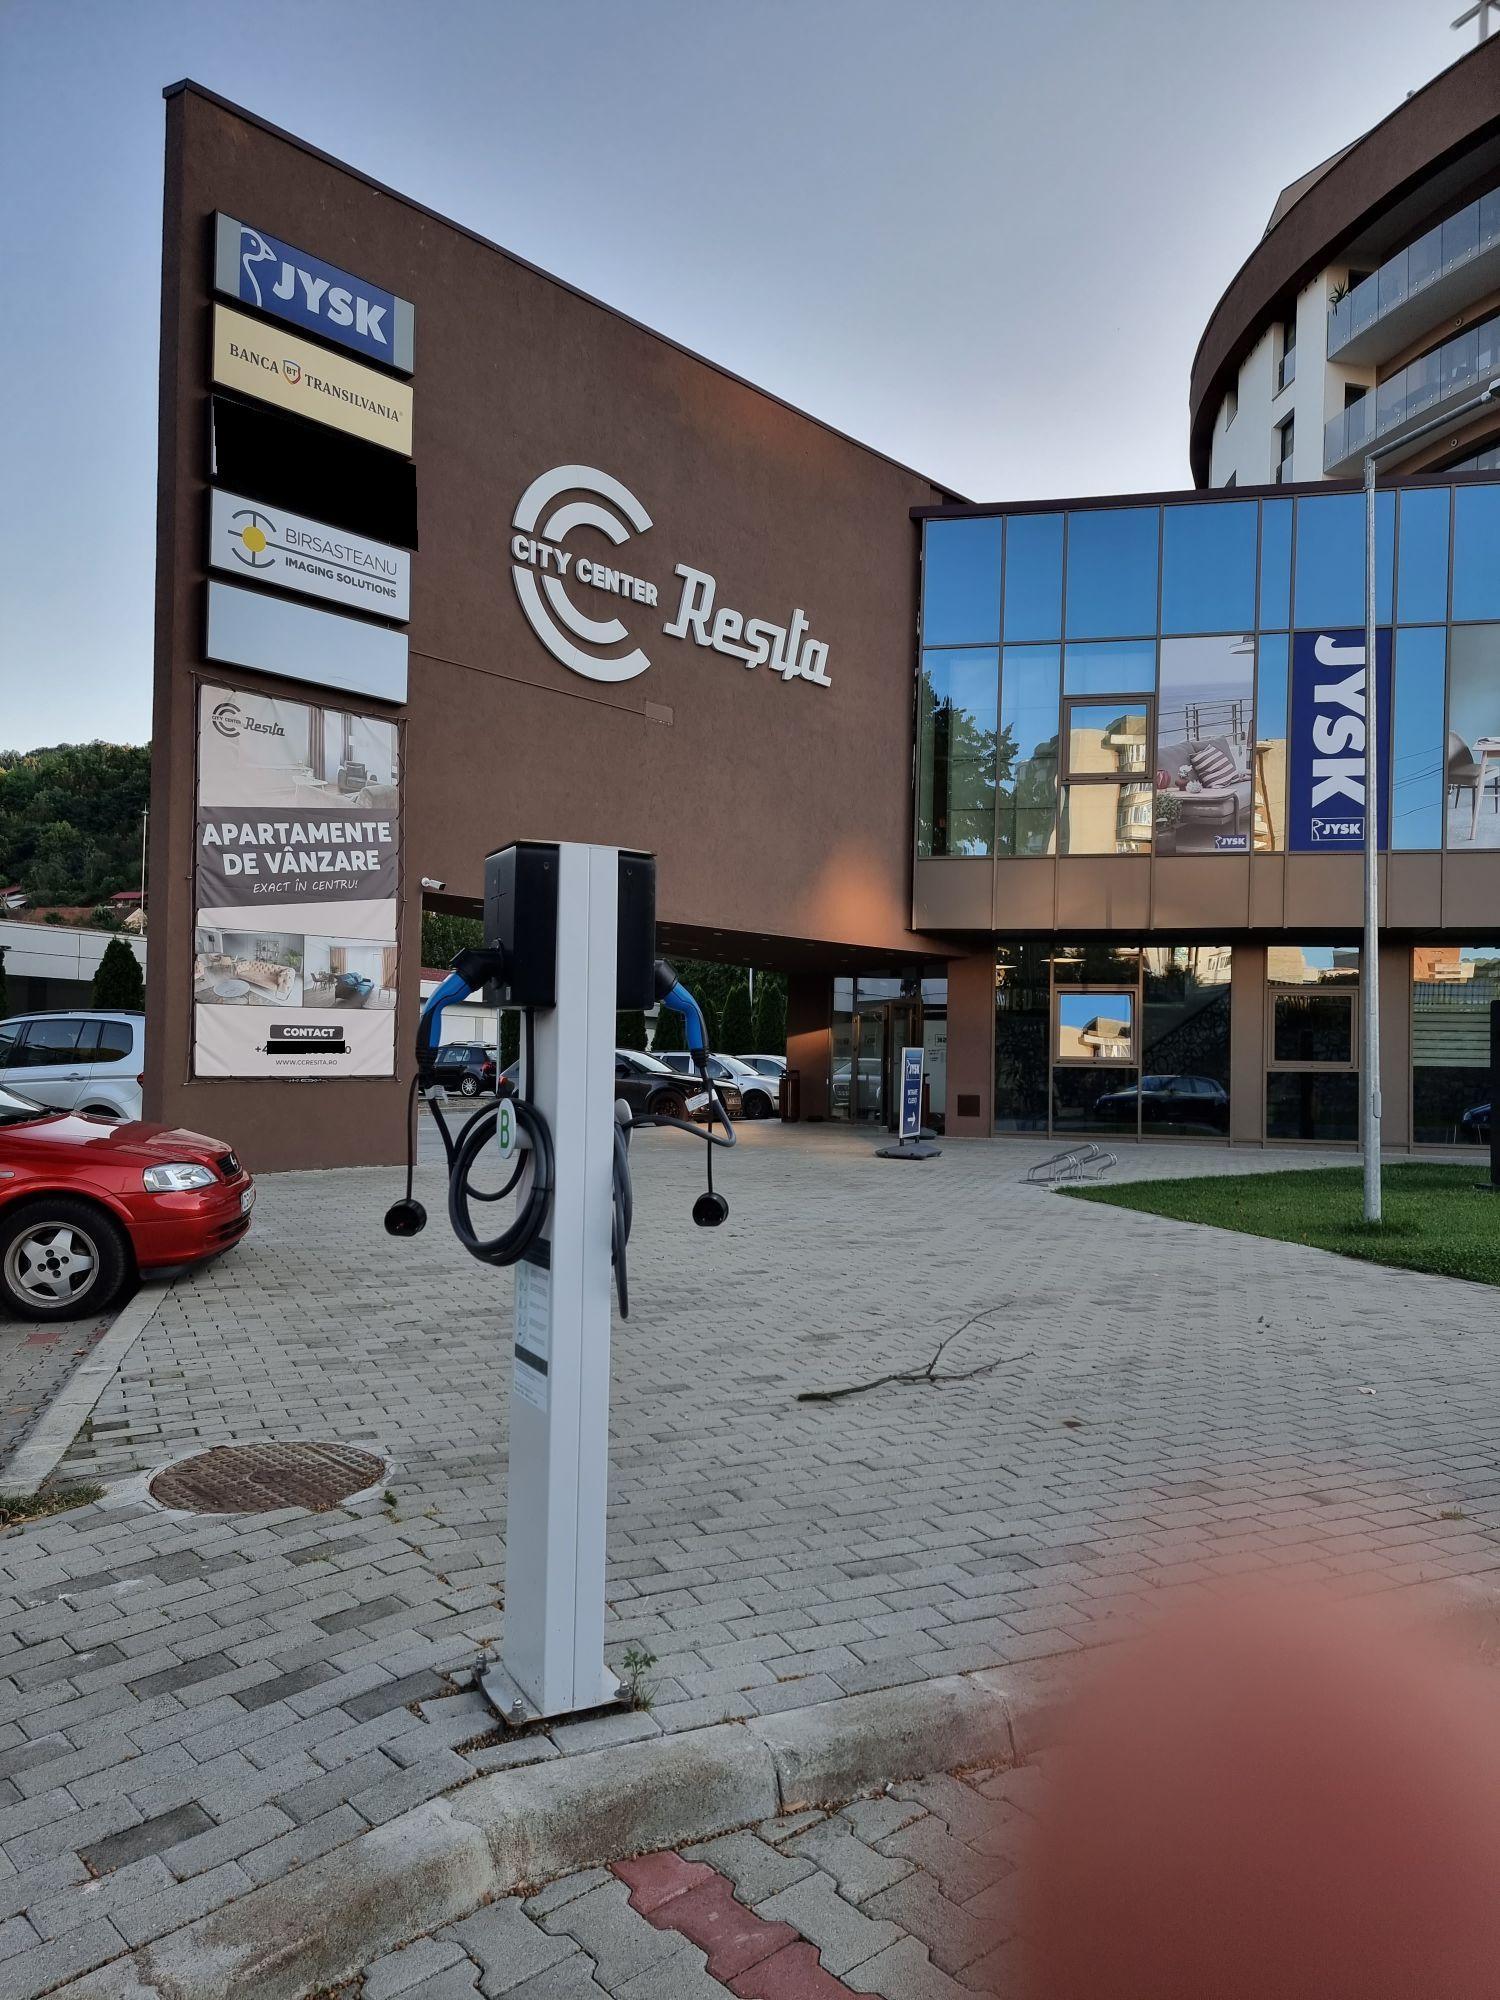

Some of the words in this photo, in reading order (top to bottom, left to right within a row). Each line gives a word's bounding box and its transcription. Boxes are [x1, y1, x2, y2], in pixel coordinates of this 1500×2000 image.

[272, 261, 387, 345] JYSK
[229, 343, 280, 375] BANCA
[286, 365, 298, 377] BT
[304, 373, 400, 423] TRANSILVANIA
[285, 527, 397, 576] BIRSASTEANU
[285, 556, 334, 580] IMAGING
[336, 572, 397, 599] SOLUTIONS
[511, 534, 573, 574] CITY
[575, 558, 658, 607] CENTER
[1312, 634, 1366, 809] JYSK
[202, 822, 392, 846] APARTAMENTE
[1221, 837, 1246, 846] JYSK
[1322, 823, 1361, 835] JYSK
[222, 852, 260, 876] DE
[263, 846, 381, 874] VÂNZARE
[253, 881, 291, 894] EXACT
[295, 879, 307, 892] ÎN
[312, 879, 359, 891] CENTRU!
[283, 1027, 335, 1037] CONTACT
